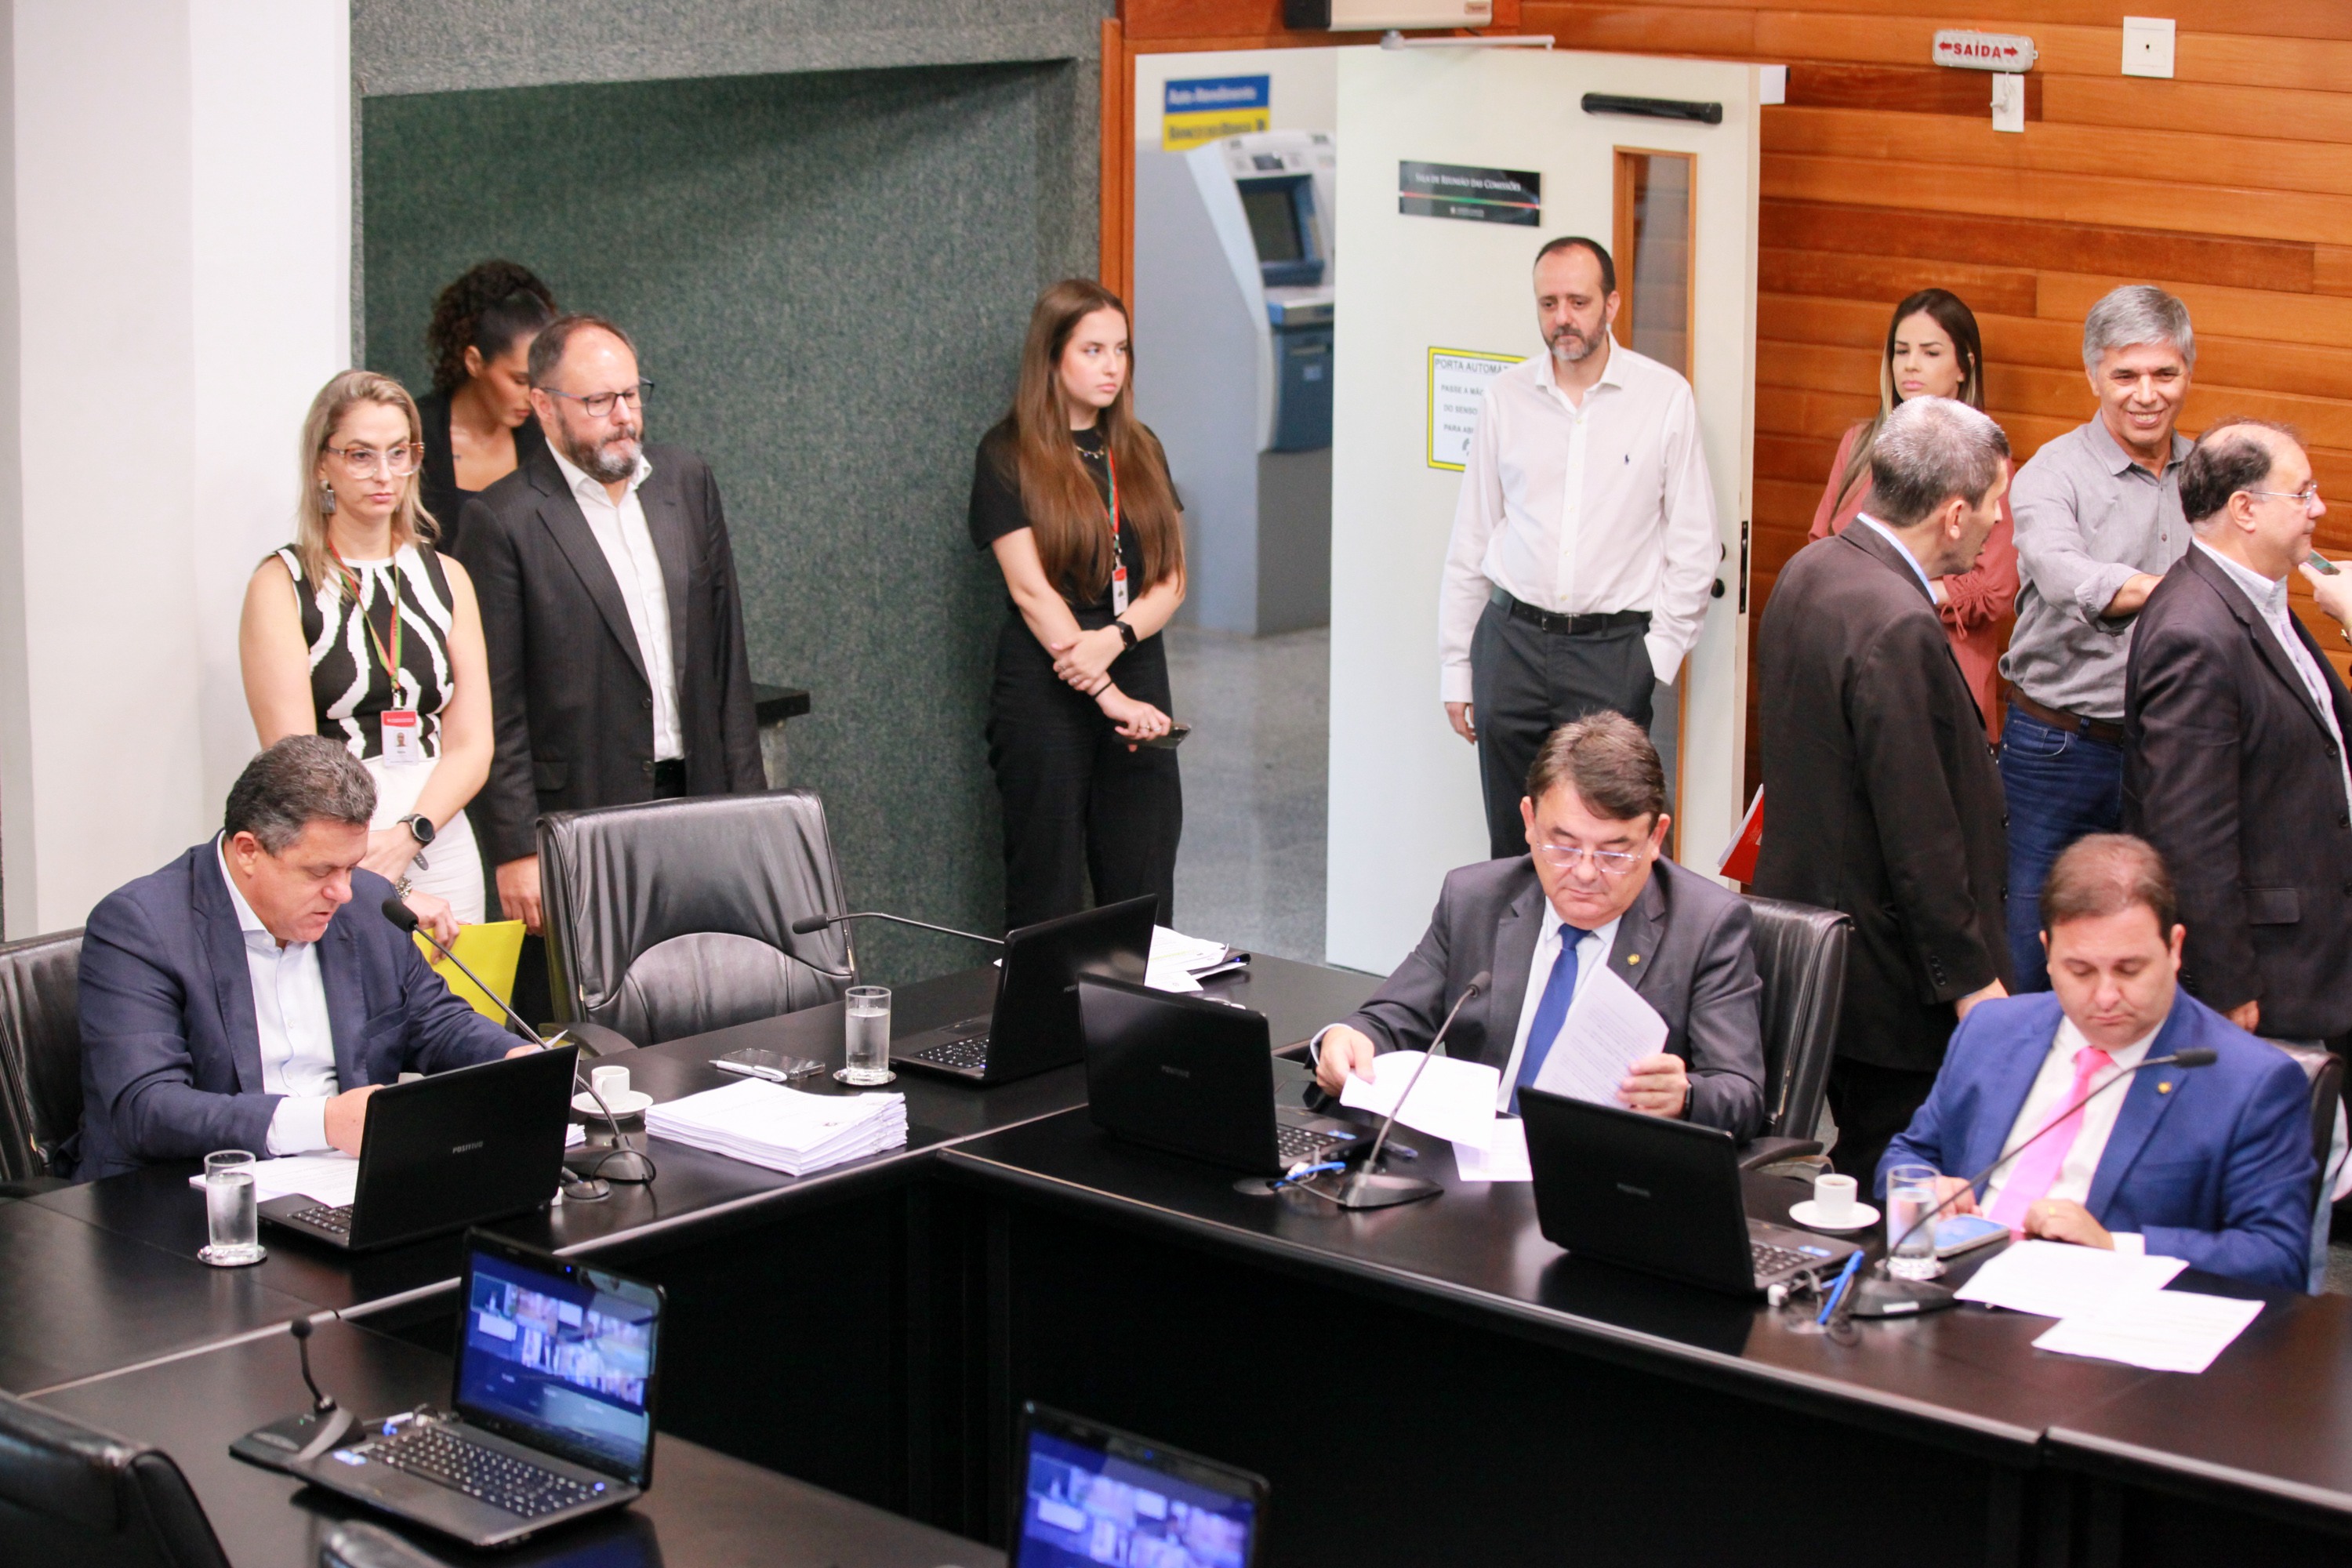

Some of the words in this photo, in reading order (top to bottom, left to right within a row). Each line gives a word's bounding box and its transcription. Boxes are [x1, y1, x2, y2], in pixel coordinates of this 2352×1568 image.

[1954, 40, 2002, 58] SAÍDA
[1435, 358, 1464, 371] PORTA
[1466, 361, 1508, 374] AUTOMÁ
[1441, 384, 1462, 394] PASSE
[1443, 404, 1454, 412] DO
[1443, 423, 1461, 433] PARA
